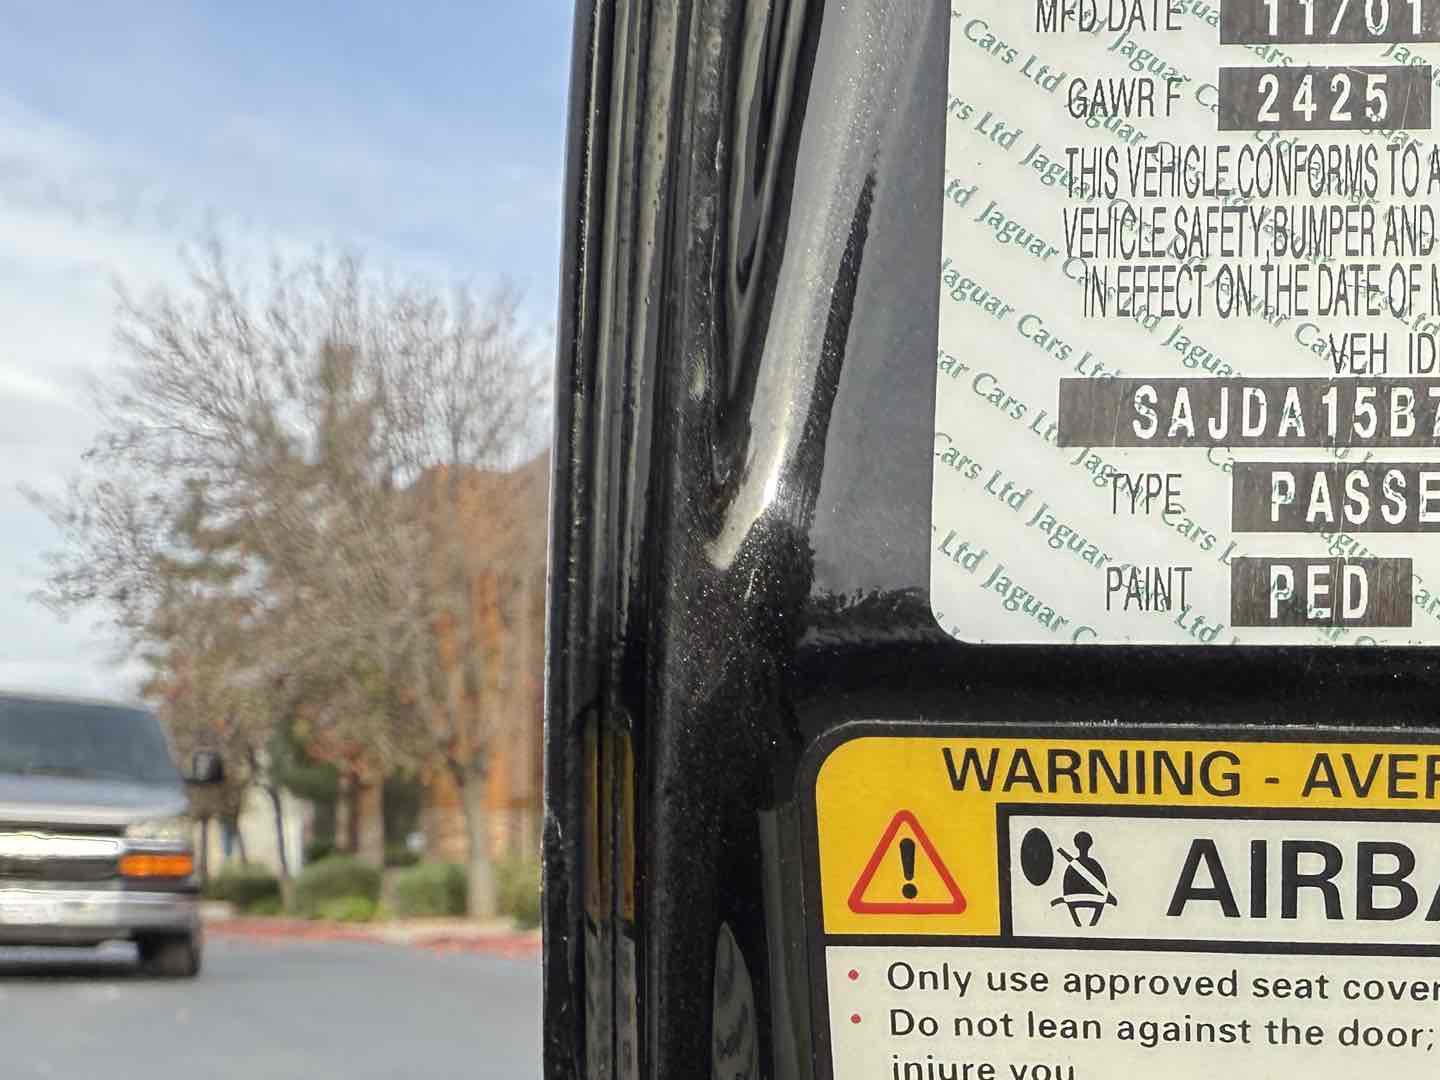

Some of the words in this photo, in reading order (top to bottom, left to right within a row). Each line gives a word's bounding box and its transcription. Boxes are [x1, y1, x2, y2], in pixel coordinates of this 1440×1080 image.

[1035, 0, 1098, 33] MFD
[1108, 0, 1183, 32] DATE
[1256, 0, 1424, 37] 11/01
[1067, 76, 1156, 119] GAWR
[1165, 77, 1182, 117] F
[1257, 72, 1390, 122] 2425
[1066, 144, 1120, 200] THIS
[1126, 144, 1232, 198] VEHICLE
[1237, 143, 1379, 199] CONFORMS
[1386, 143, 1421, 198] TO
[1064, 206, 1166, 259] VEHICLE
[1273, 204, 1377, 257] BUMPER
[1384, 203, 1437, 257] AND
[1084, 266, 1108, 318] IN
[1116, 264, 1208, 319] EFFECT
[1215, 264, 1254, 319] ON
[1260, 264, 1311, 317] THE
[1317, 263, 1382, 317] DATE
[1388, 262, 1423, 318] OF
[1330, 331, 1388, 374] VEH
[1107, 473, 1183, 515] TYPE
[1106, 566, 1193, 611] PAINT
[1269, 564, 1370, 619] PED
[942, 748, 1241, 797] WARNING
[887, 961, 973, 998] Only
[986, 972, 1050, 993] use
[1063, 969, 1239, 1001] approved
[1252, 974, 1330, 1001] seat
[889, 1008, 939, 1038] Do
[954, 1013, 1014, 1039] not
[1028, 1011, 1103, 1040] lean
[1117, 1014, 1252, 1049] against
[1265, 1017, 1325, 1047] the
[1337, 1018, 1435, 1052] door;
